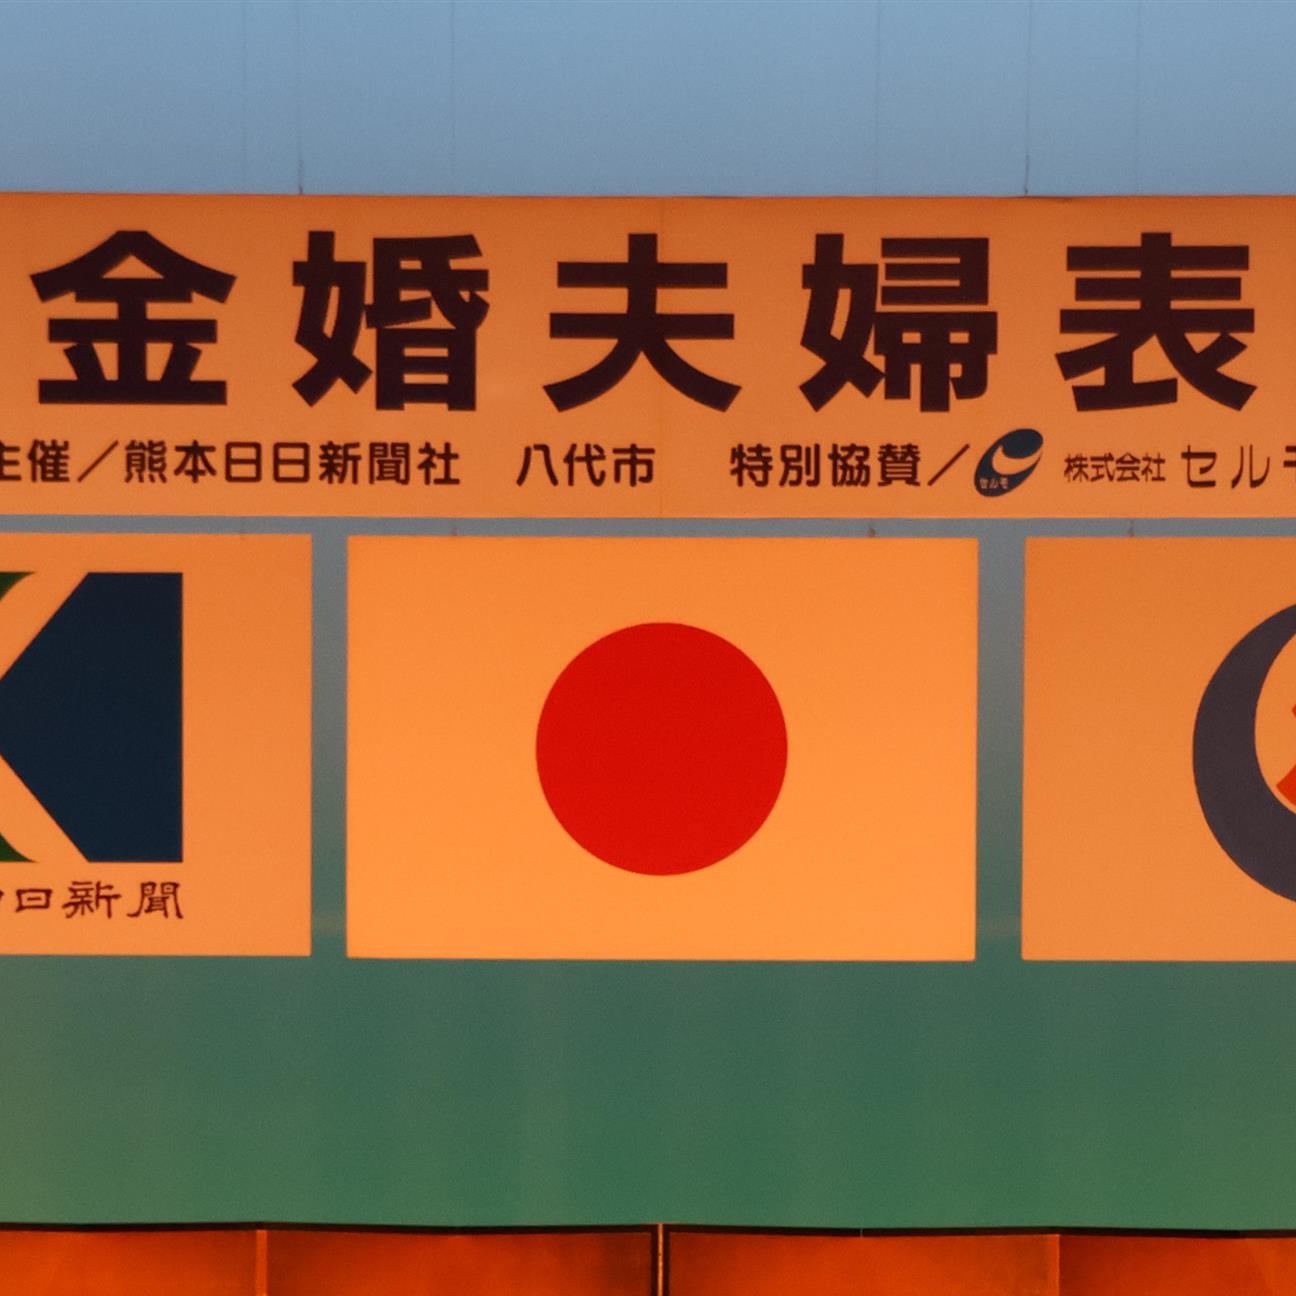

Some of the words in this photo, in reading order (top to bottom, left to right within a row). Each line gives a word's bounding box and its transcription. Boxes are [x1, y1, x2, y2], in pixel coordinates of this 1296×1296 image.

[516, 443, 656, 488] 八代市
[1063, 452, 1166, 482] 株式会社
